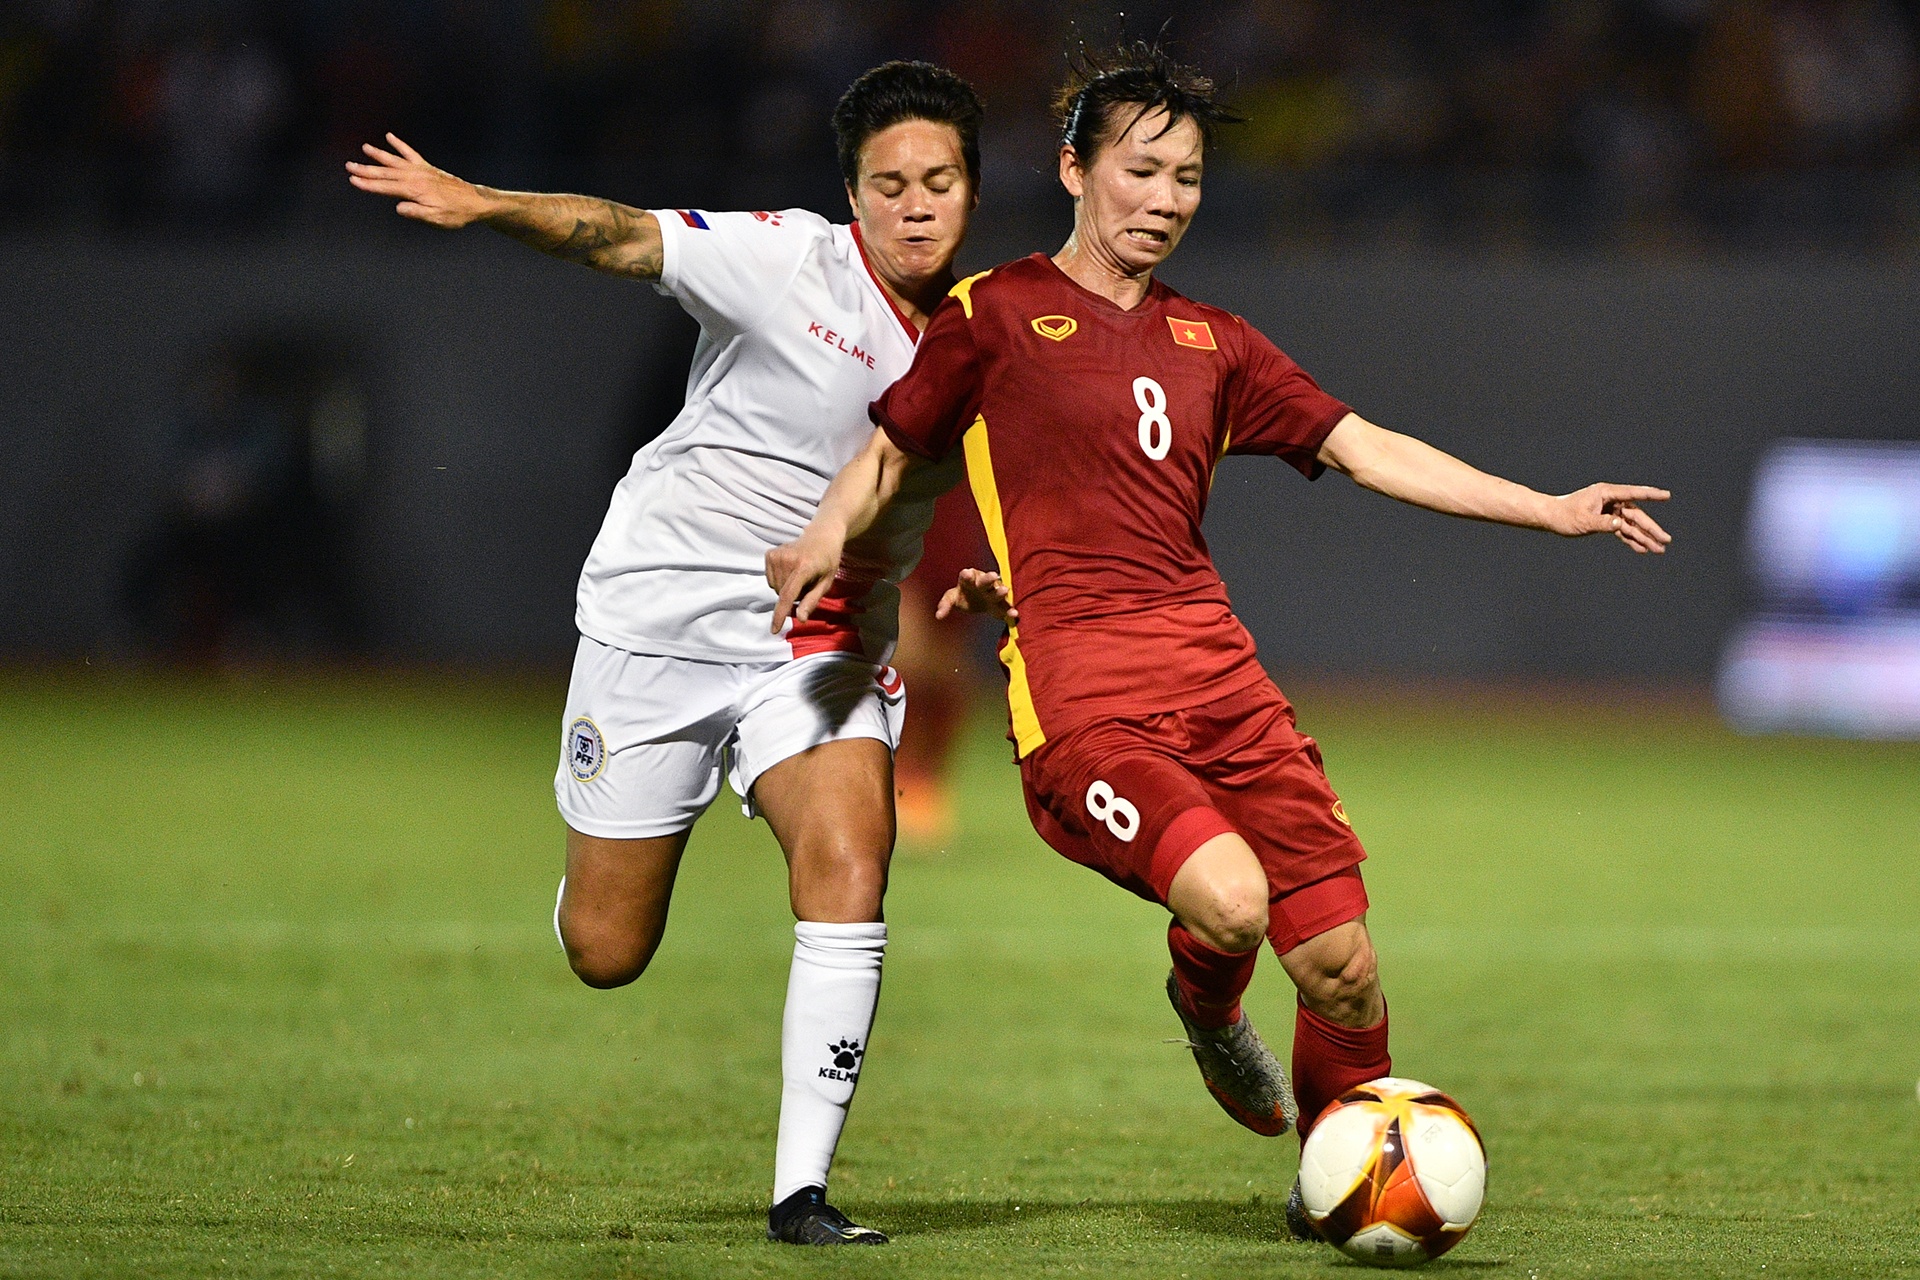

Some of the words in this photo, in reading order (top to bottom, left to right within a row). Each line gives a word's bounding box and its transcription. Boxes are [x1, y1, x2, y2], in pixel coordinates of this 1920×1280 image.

[808, 321, 876, 370] KELME
[1132, 376, 1172, 461] 8
[575, 751, 594, 766] PFF
[1085, 780, 1140, 842] 8
